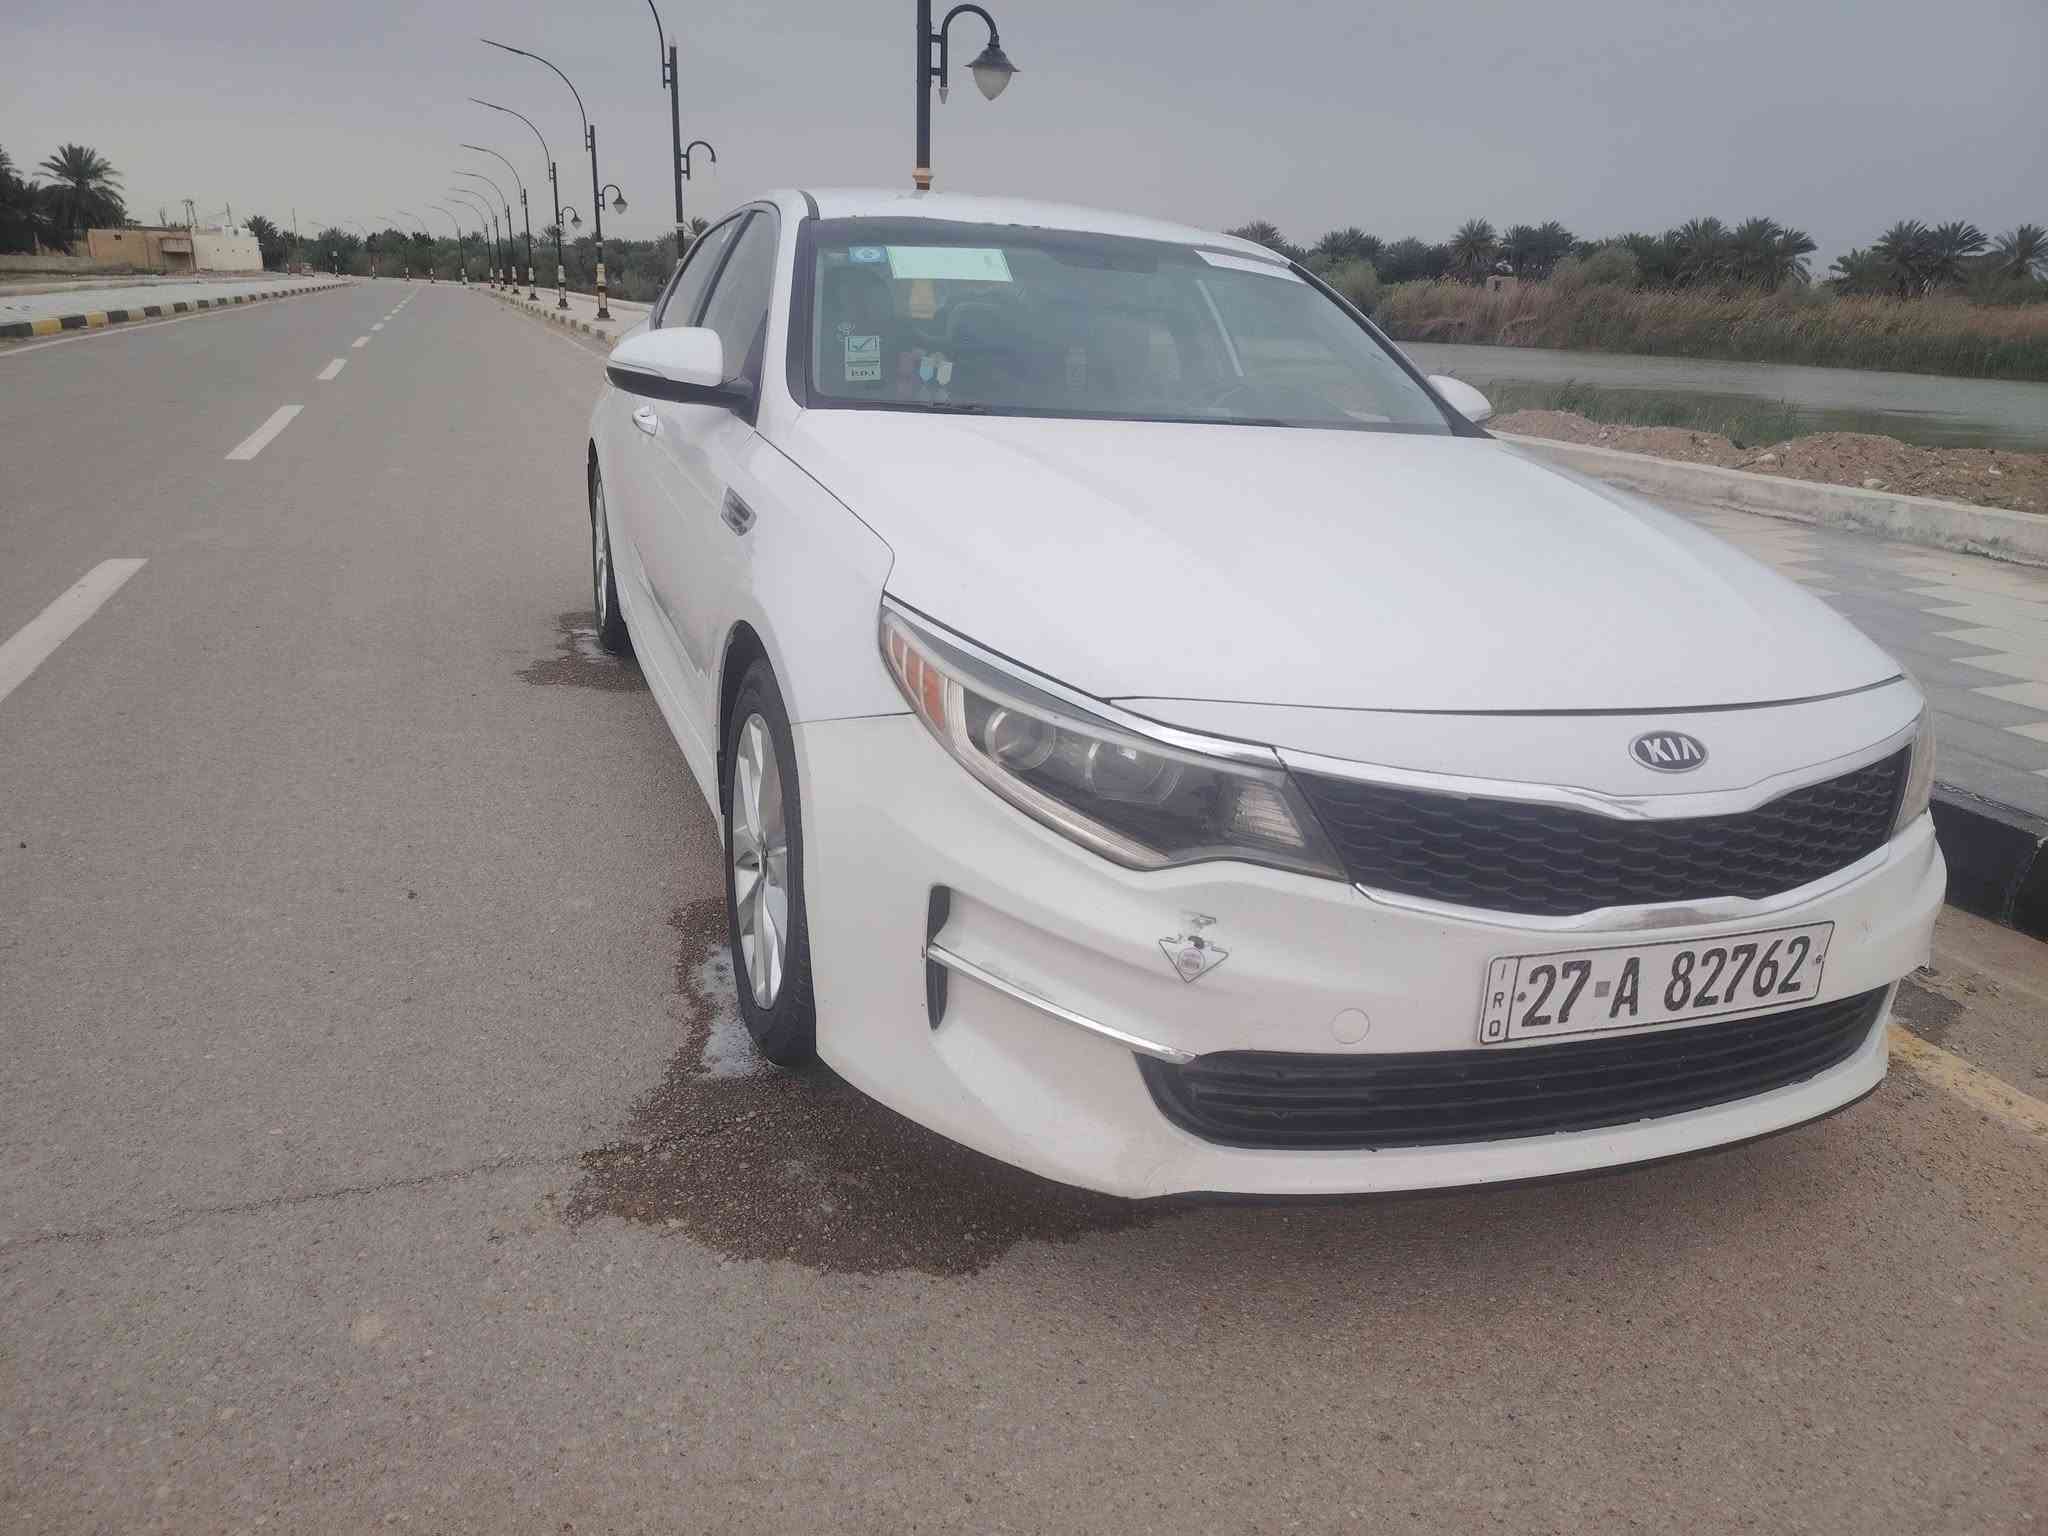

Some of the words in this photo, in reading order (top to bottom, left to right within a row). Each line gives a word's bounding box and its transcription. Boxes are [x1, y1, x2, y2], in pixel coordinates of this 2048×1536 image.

[1641, 736, 1701, 763] KIA
[1521, 959, 1592, 1027] 27
[1609, 956, 1640, 1018] A
[1664, 935, 1811, 1011] 82762
